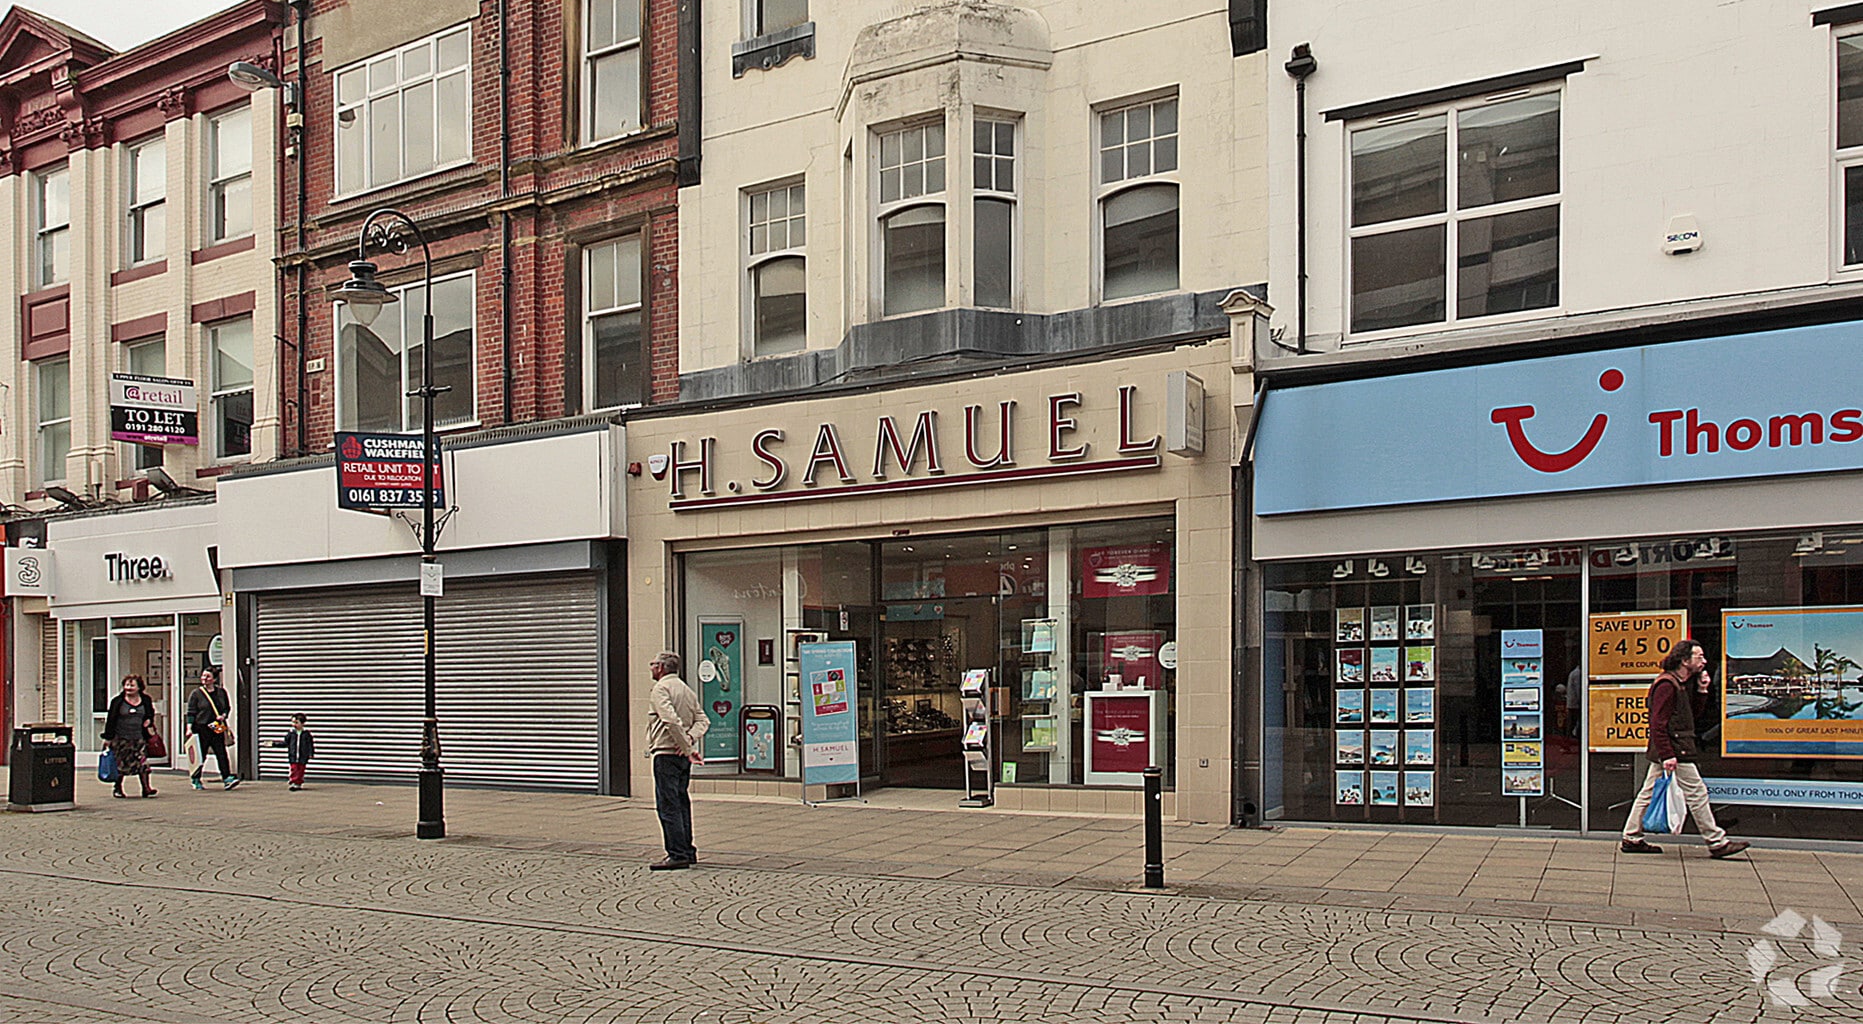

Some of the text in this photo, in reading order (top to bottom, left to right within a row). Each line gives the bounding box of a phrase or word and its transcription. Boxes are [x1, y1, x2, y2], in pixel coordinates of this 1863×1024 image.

[1667, 231, 1698, 242] SECOM
[124, 409, 185, 425] TO LET
[125, 423, 186, 434] 0191 280 4120
[1648, 407, 1863, 458] Thoms
[364, 449, 425, 459] WAKEFIEL
[343, 462, 376, 473] RETAIL
[378, 464, 402, 474] UNIT
[406, 464, 421, 475] TO
[348, 489, 438, 503] 0161 837 355
[18, 557, 41, 584] 3
[1594, 618, 1676, 633] SAVE UP TO
[1614, 712, 1650, 724] KIDS
[1740, 788, 1759, 796] FOR
[1783, 789, 1807, 798] ONLY
[1809, 790, 1836, 799] FROM
